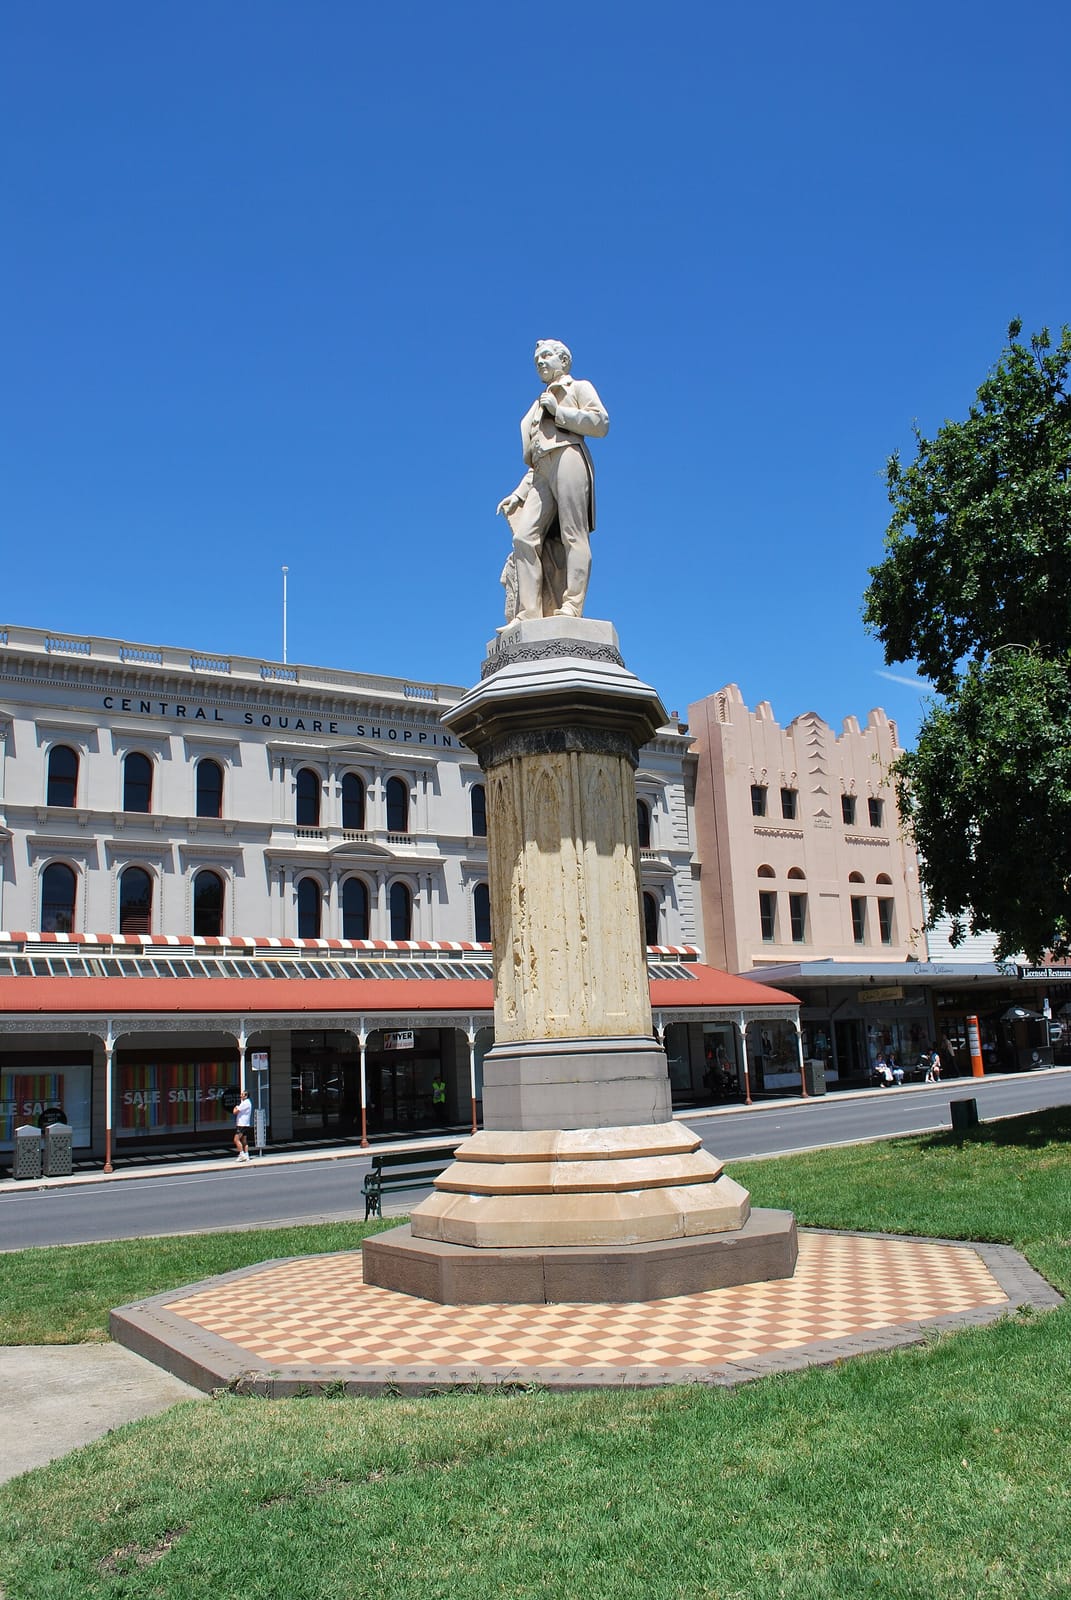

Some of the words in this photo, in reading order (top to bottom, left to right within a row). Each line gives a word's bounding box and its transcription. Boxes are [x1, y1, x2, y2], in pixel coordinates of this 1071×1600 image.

[103, 696, 224, 721] CENTRAL
[244, 712, 338, 734] SQUARE
[1023, 968, 1047, 977] Licensed
[392, 1032, 412, 1040] MYER
[124, 1090, 161, 1105] SALE
[168, 1089, 203, 1103] SALE
